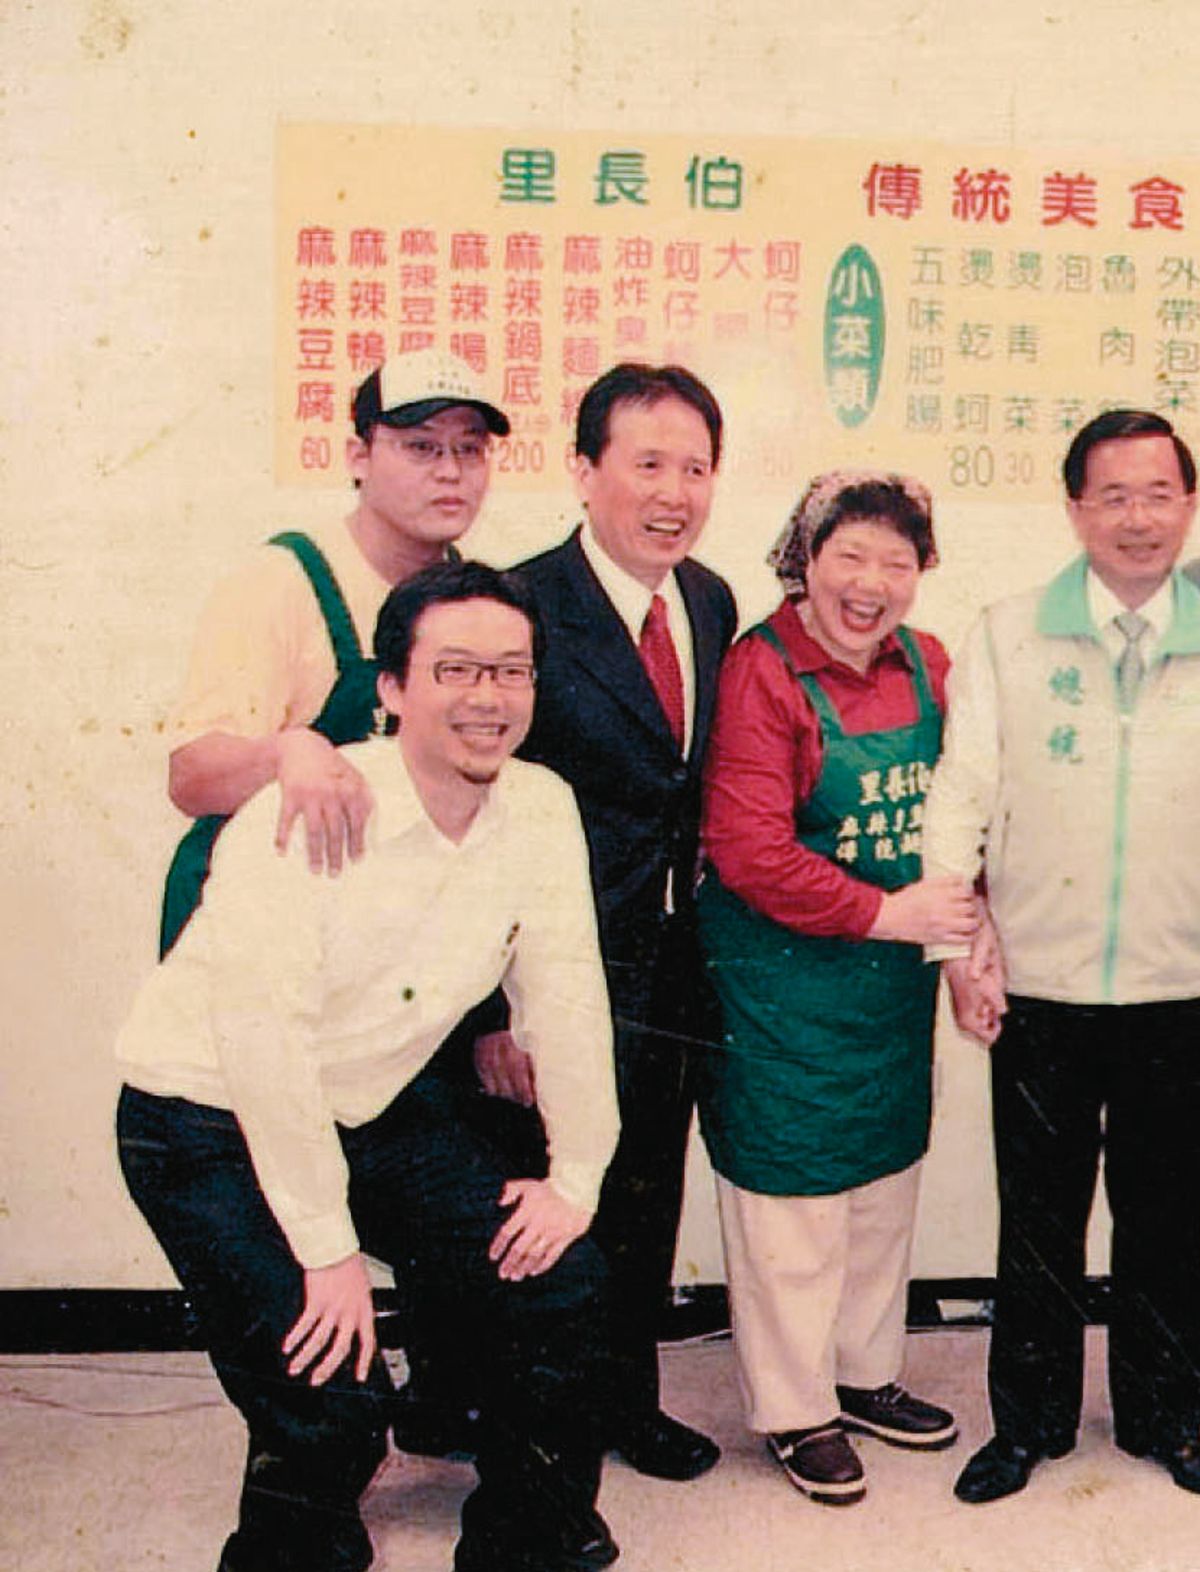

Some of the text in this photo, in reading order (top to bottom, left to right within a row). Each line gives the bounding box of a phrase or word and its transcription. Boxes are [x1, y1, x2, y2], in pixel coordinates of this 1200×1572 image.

[499, 148, 1186, 232] 里長伯 傳統美食
[297, 226, 336, 423] 麻辣豆腐
[347, 227, 386, 418] 麻辣鴨
[503, 232, 544, 405] 麻辣鍋底
[905, 247, 945, 435] 五味肥腸
[498, 440, 545, 473] 200
[951, 445, 995, 487] 80
[1004, 451, 1035, 485] 30
